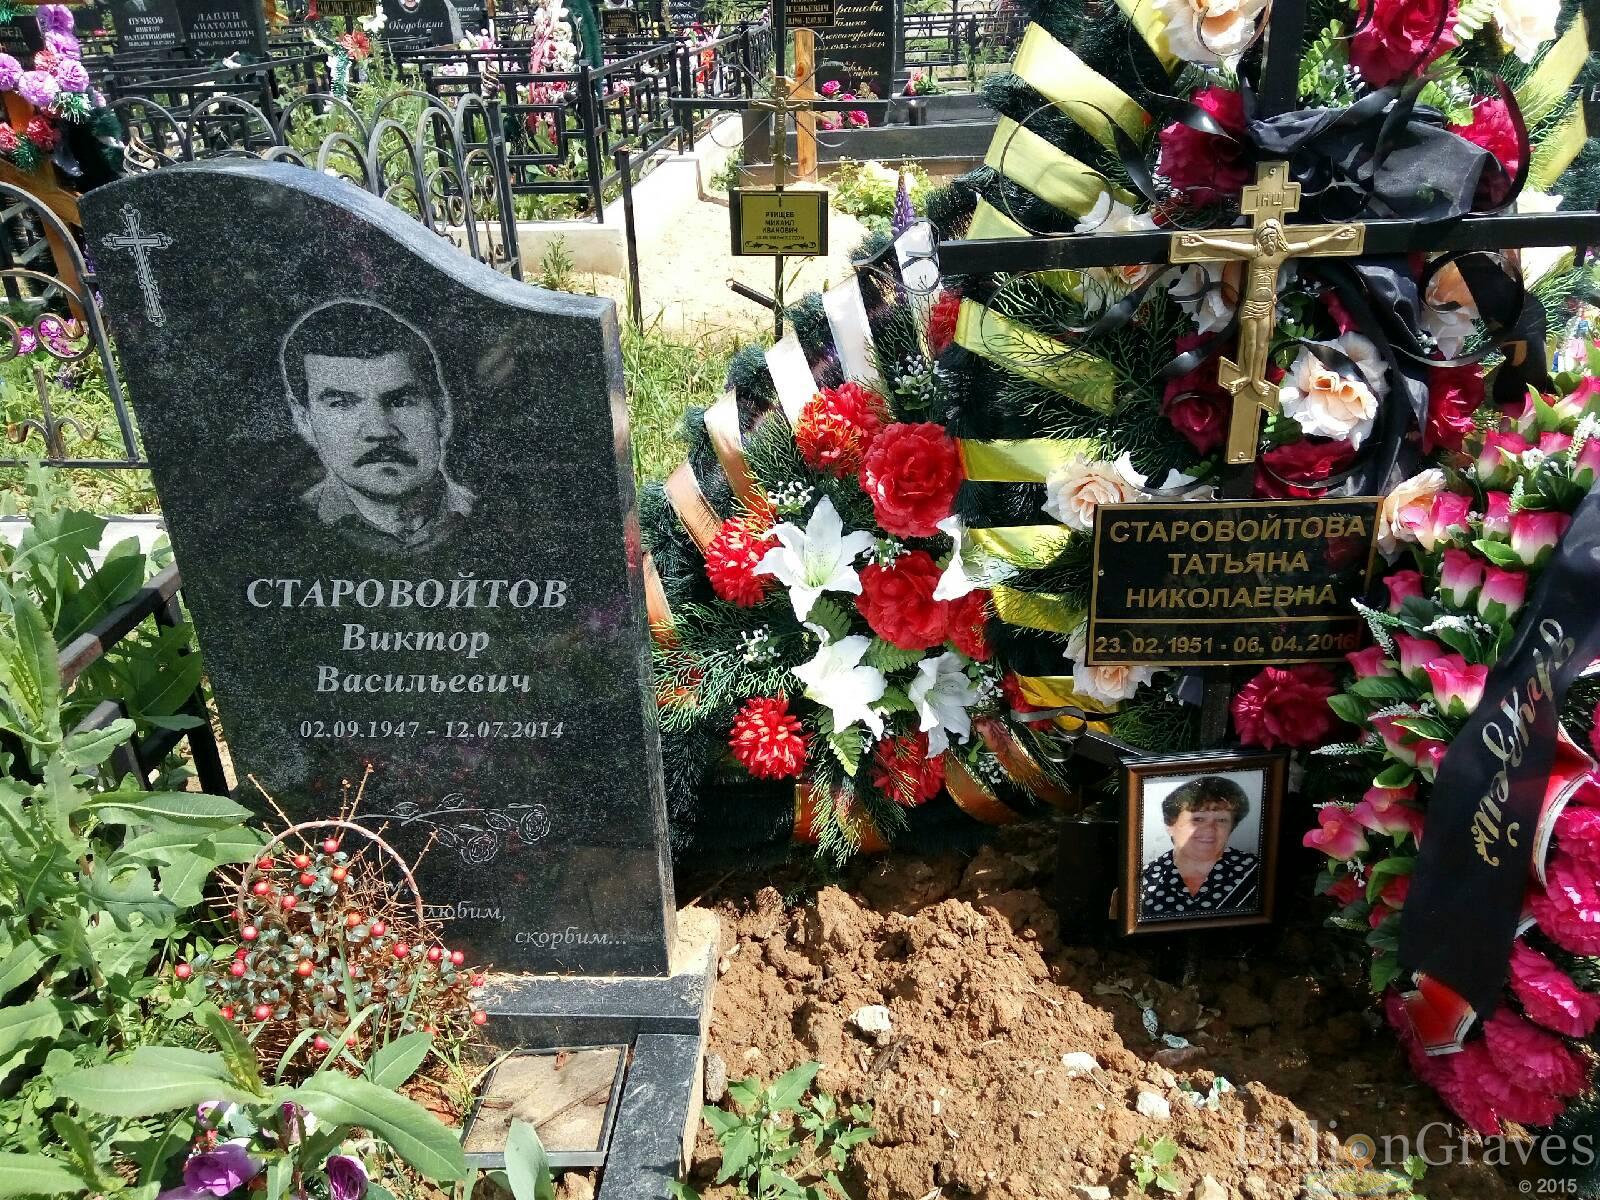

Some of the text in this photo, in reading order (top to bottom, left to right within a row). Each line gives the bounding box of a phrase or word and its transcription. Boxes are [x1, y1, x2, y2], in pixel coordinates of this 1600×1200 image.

[785, 4, 829, 13] ГЕНЬЕВИЧ
[128, 16, 164, 26] ПУЧКОВ
[190, 30, 256, 40] НИКОЛАЕВИЧ
[762, 226, 798, 234] ИВАНОВИЧ
[1109, 513, 1367, 543] СТАРОВОЙТОВА
[1168, 550, 1310, 576] ТАТЬЯНА
[246, 571, 568, 609] СТАРОВОЙТОВ
[1125, 584, 1337, 609] НИКОЛАЕВНА
[340, 623, 490, 659] Виктор
[1095, 637, 1126, 653] 23.
[1132, 637, 1163, 653] 02.
[1168, 636, 1213, 654] 1951
[1233, 636, 1265, 653] 06.
[1271, 636, 1303, 652] 04.
[316, 665, 531, 694] Васильевич
[300, 720, 420, 739] 02.09.1947
[445, 719, 565, 740] 12.07.2014
[515, 926, 627, 950] скорбим...
